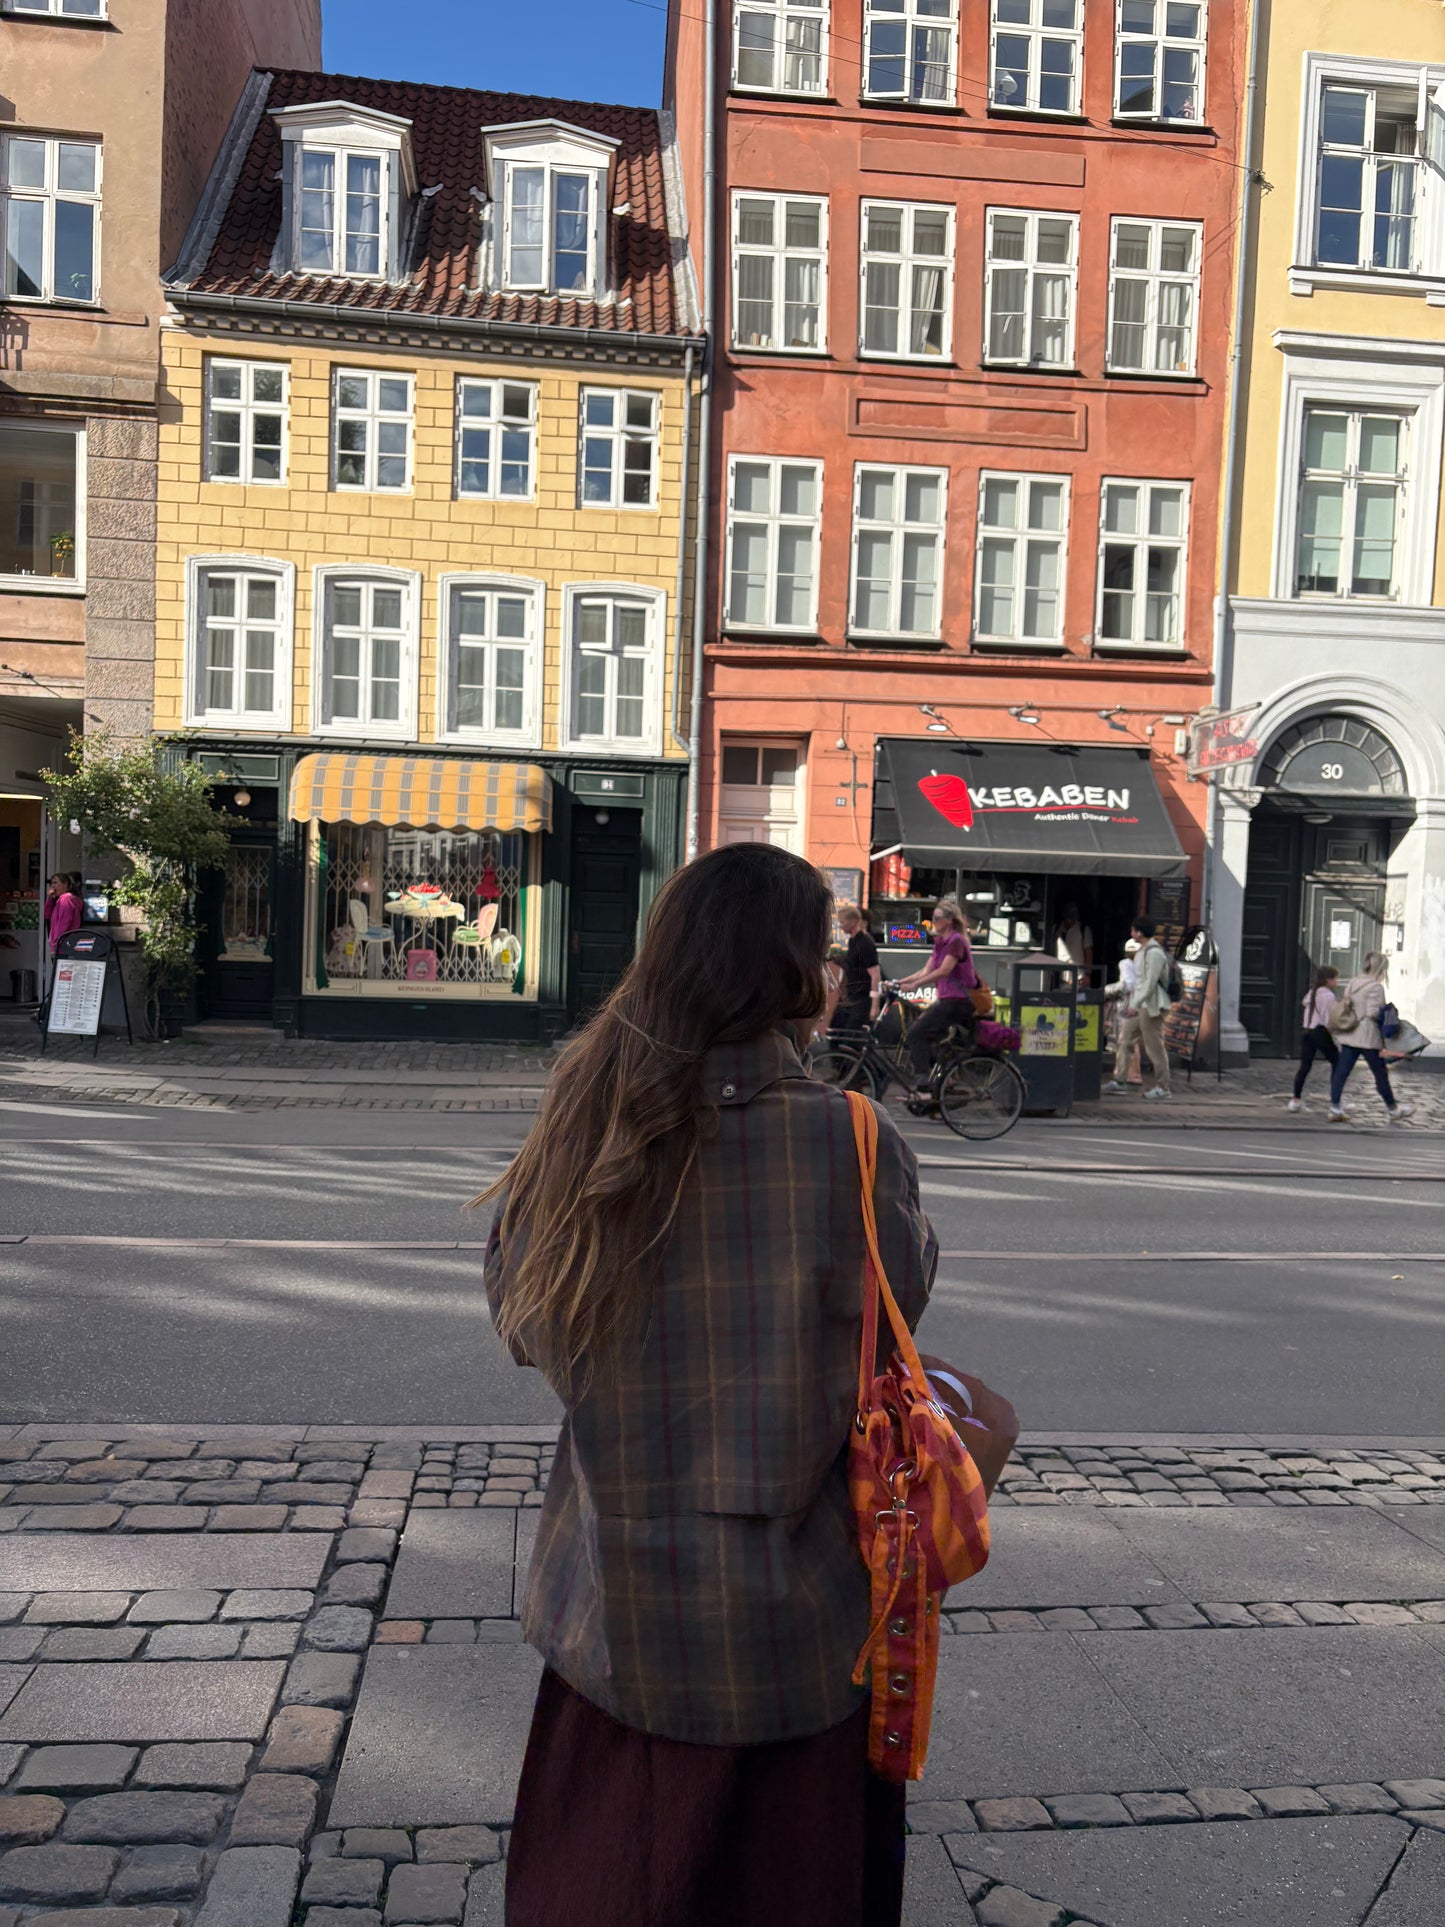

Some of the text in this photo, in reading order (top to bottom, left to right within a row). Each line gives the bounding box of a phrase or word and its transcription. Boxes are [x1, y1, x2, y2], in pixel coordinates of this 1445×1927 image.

[1320, 762, 1343, 780] 30
[967, 784, 1130, 810] KEBABEN
[1034, 812, 1080, 822] Authentic
[890, 929, 920, 939] PIZZA
